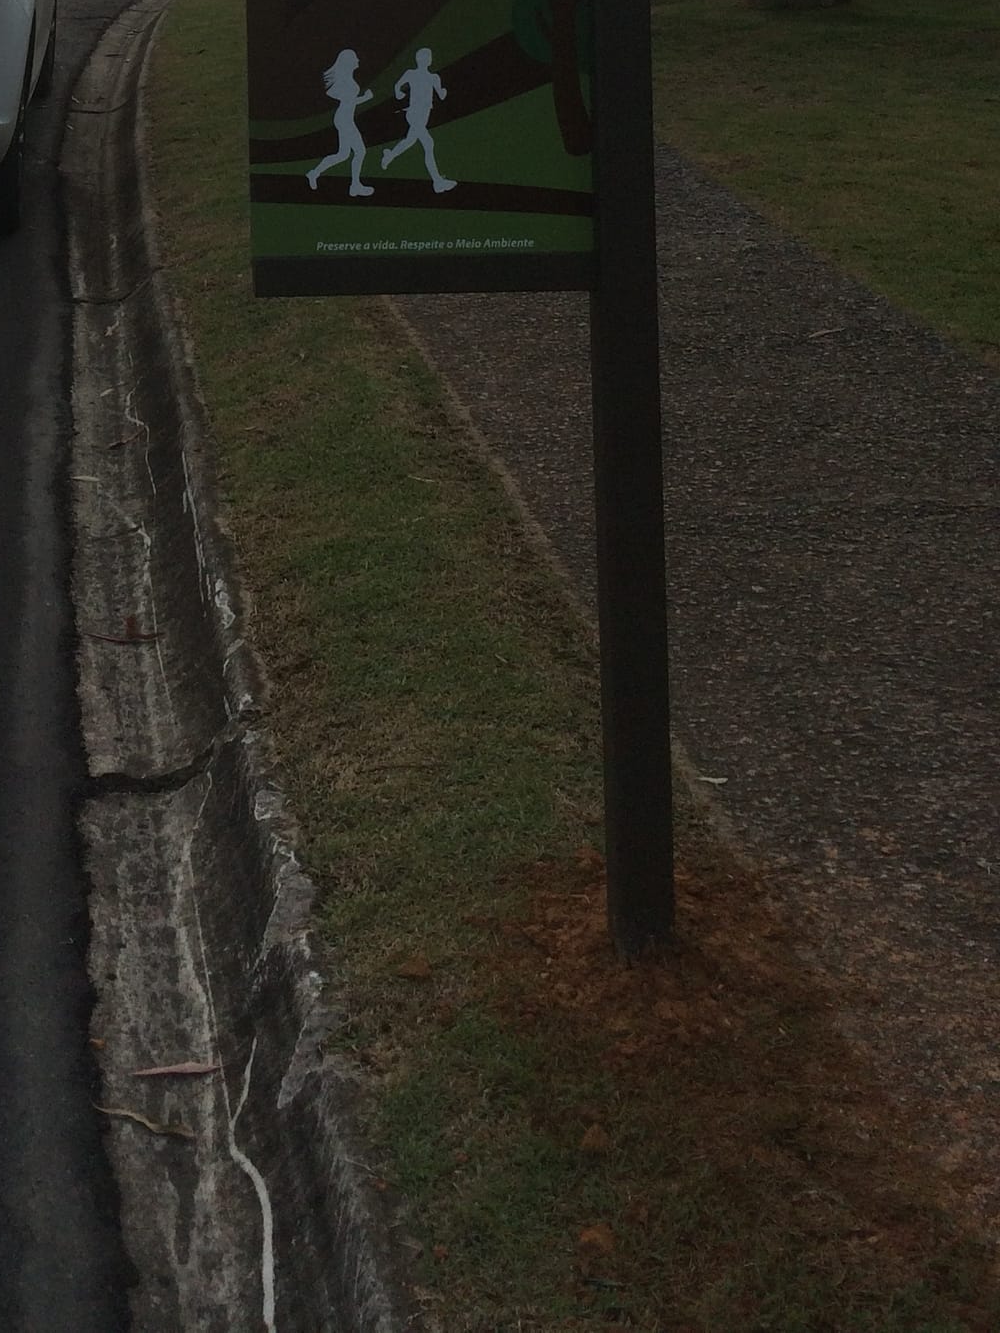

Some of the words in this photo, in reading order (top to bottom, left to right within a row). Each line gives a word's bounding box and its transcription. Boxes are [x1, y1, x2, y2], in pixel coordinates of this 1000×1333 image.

[316, 241, 361, 251] Preserve
[400, 239, 445, 251] Respeite
[455, 238, 481, 249] Meio
[483, 237, 535, 249] Ambiente
